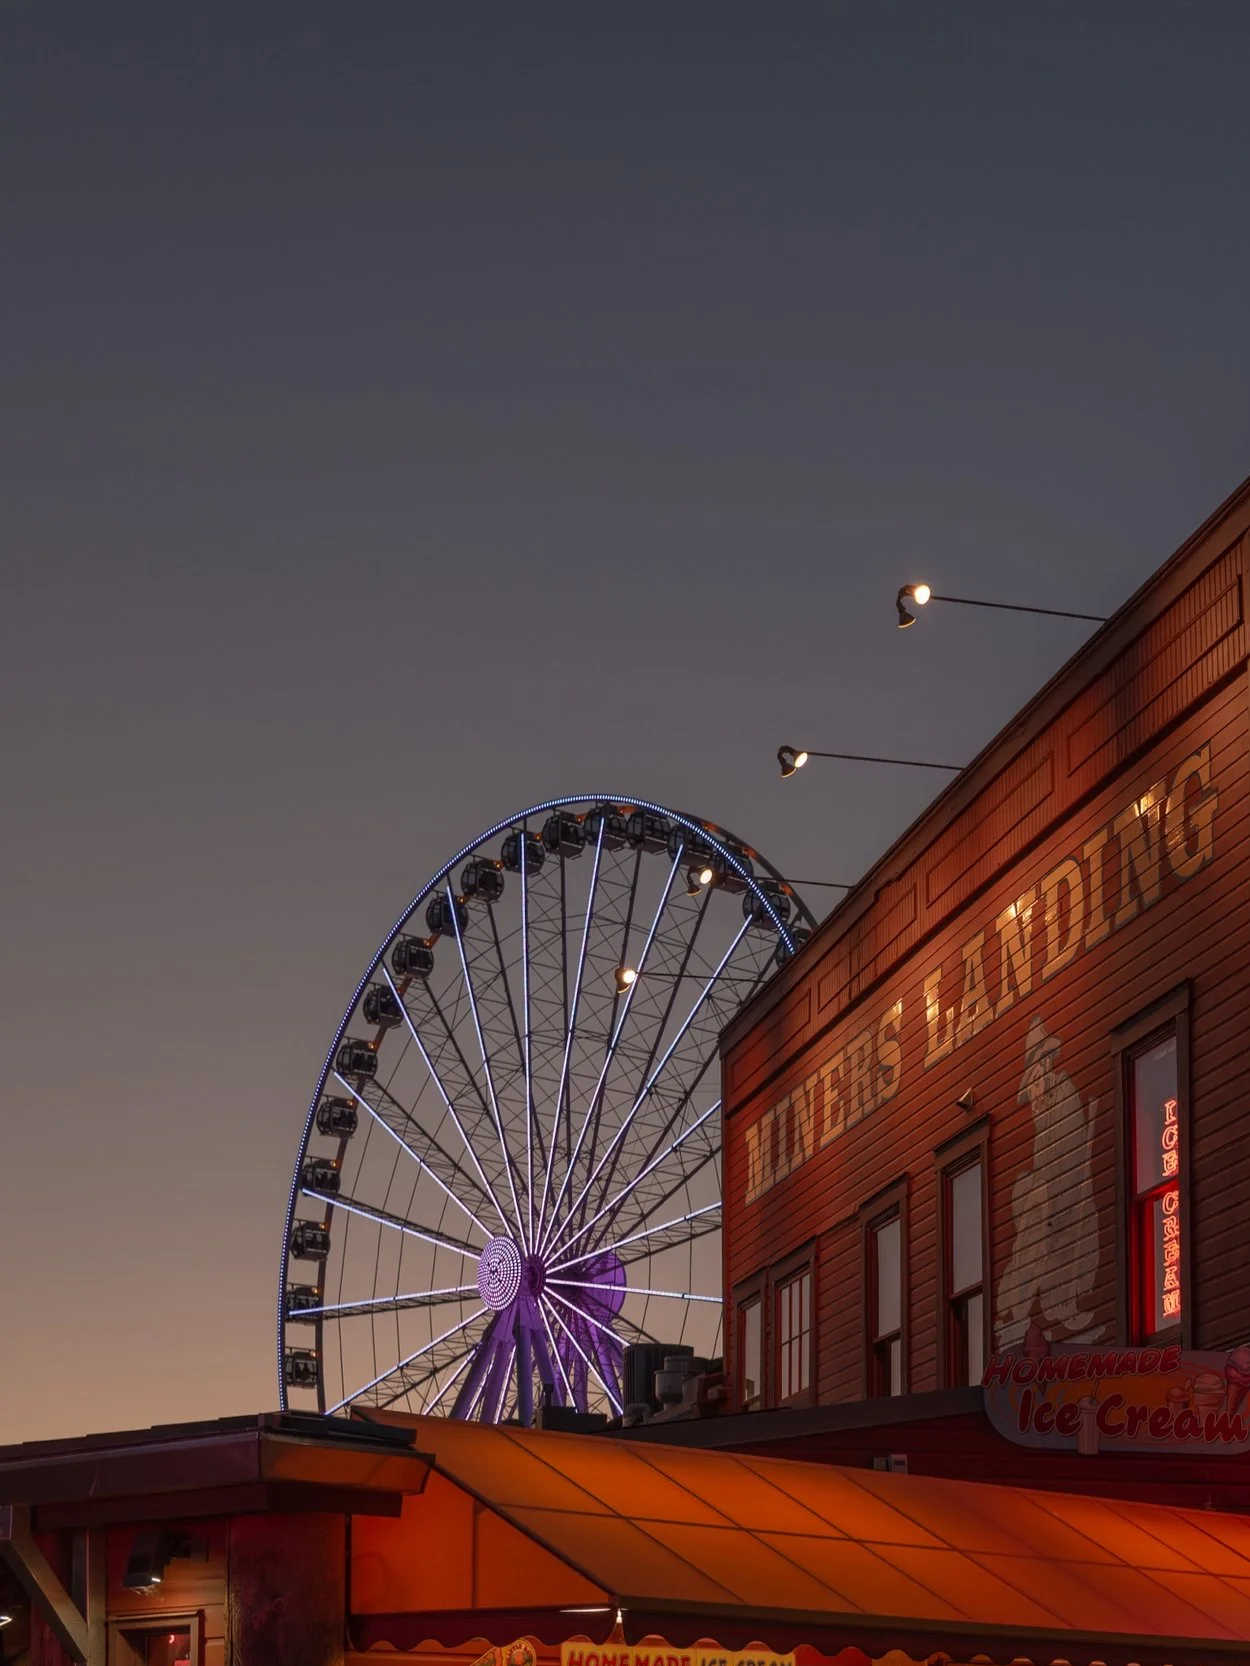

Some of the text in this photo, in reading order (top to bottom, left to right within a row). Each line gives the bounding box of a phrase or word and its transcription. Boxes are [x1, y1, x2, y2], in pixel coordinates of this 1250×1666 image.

[745, 742, 1219, 1205] MINERS LANDING
[1163, 1100, 1182, 1317] ICE CREAM
[982, 1346, 1182, 1388] HOMEMADE
[1017, 1398, 1250, 1443] Ice Cream
